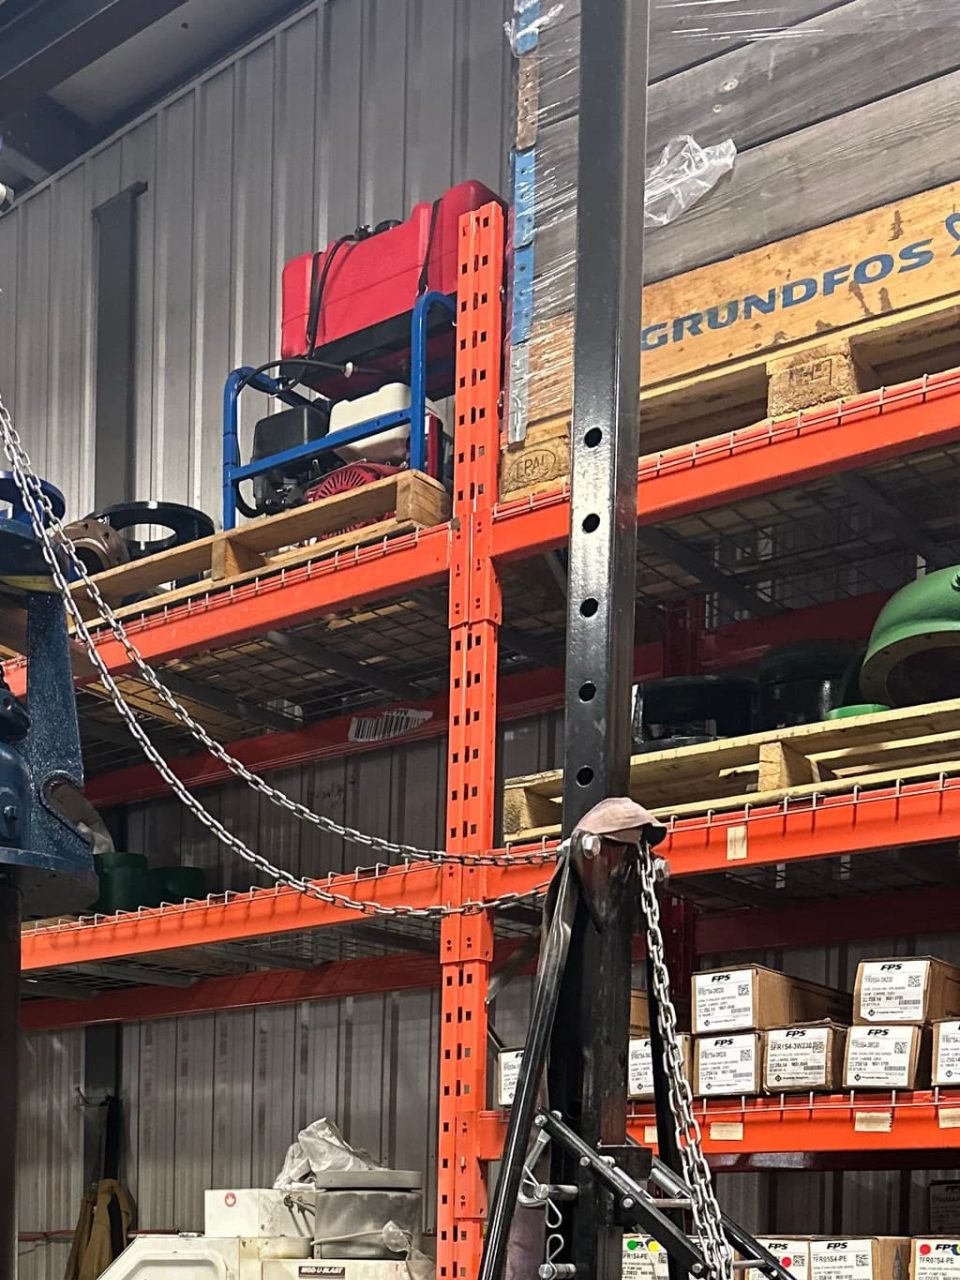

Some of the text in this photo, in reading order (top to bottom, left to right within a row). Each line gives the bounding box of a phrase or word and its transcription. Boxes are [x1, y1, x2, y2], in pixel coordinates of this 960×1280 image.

[641, 238, 935, 351] GRUNDFOS
[880, 963, 903, 971] FPS
[711, 974, 731, 982] FPS
[714, 1038, 734, 1046] FPS
